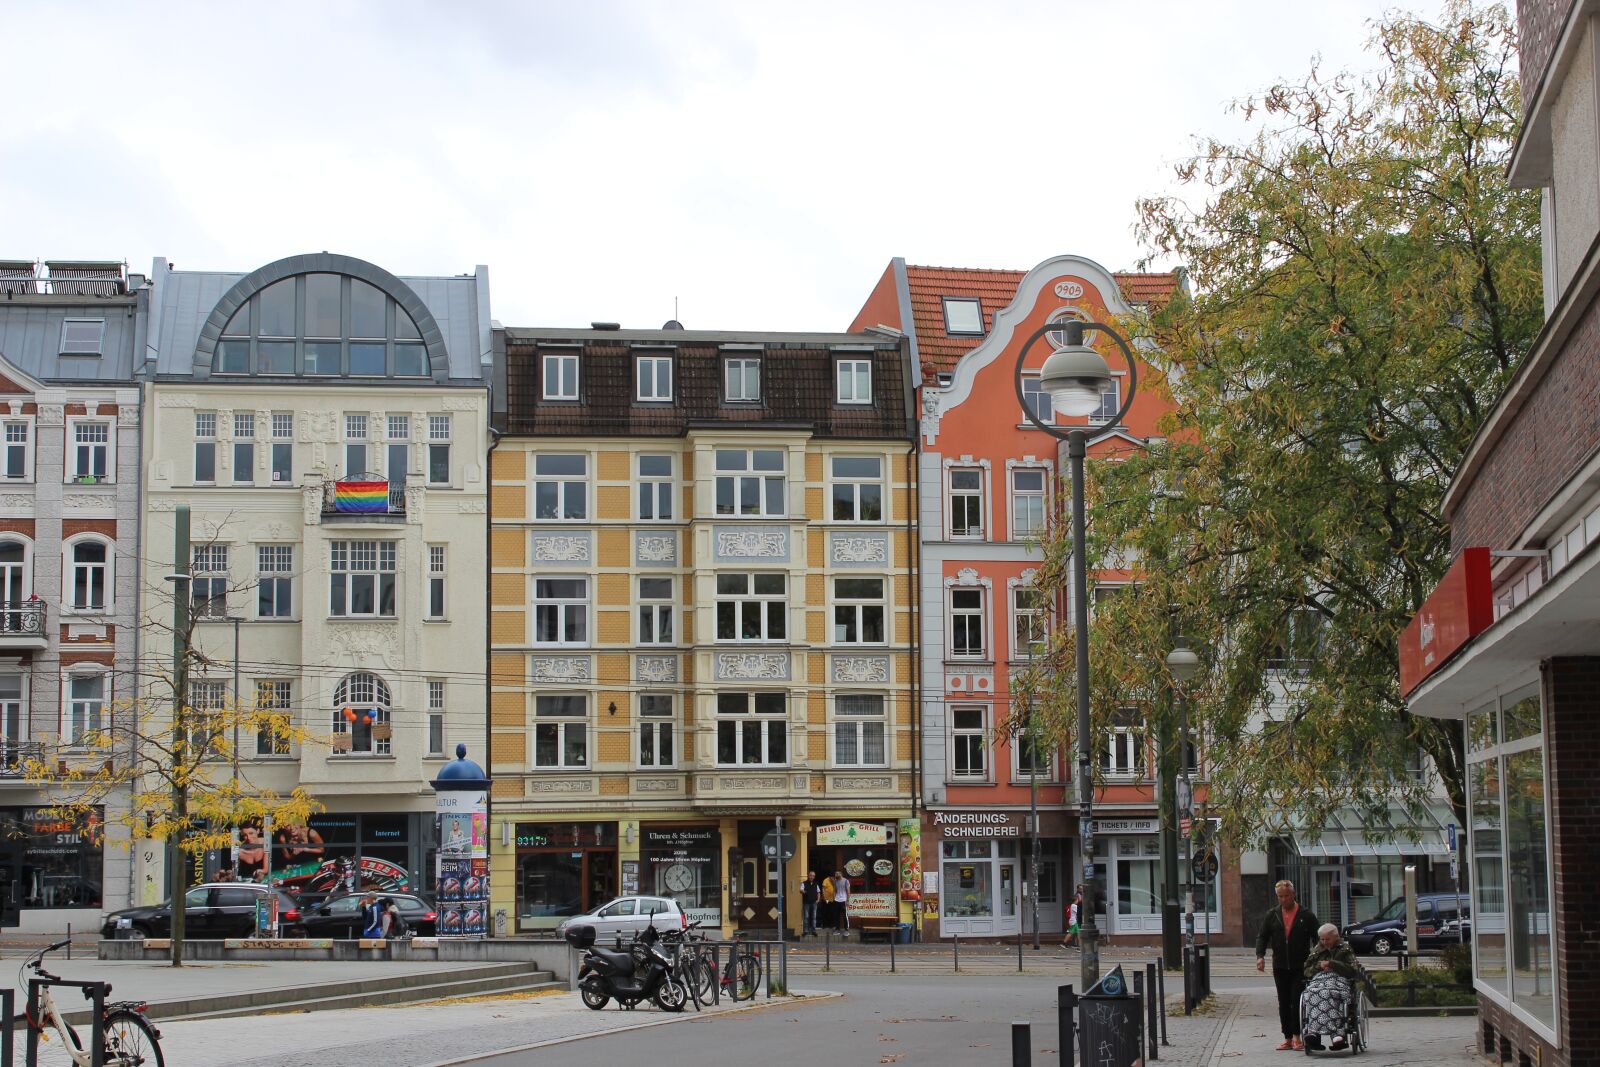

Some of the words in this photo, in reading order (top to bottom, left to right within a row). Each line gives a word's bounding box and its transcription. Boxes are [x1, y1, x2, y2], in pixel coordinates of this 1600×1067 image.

[819, 824, 845, 834] BEIRUT
[858, 823, 880, 832] GRILL
[1101, 821, 1128, 829] TICKETS
[1135, 821, 1151, 829] INFO
[944, 826, 1019, 837] SCHNEIDEREI
[56, 834, 82, 844] STIL
[190, 851, 204, 887] ASINO
